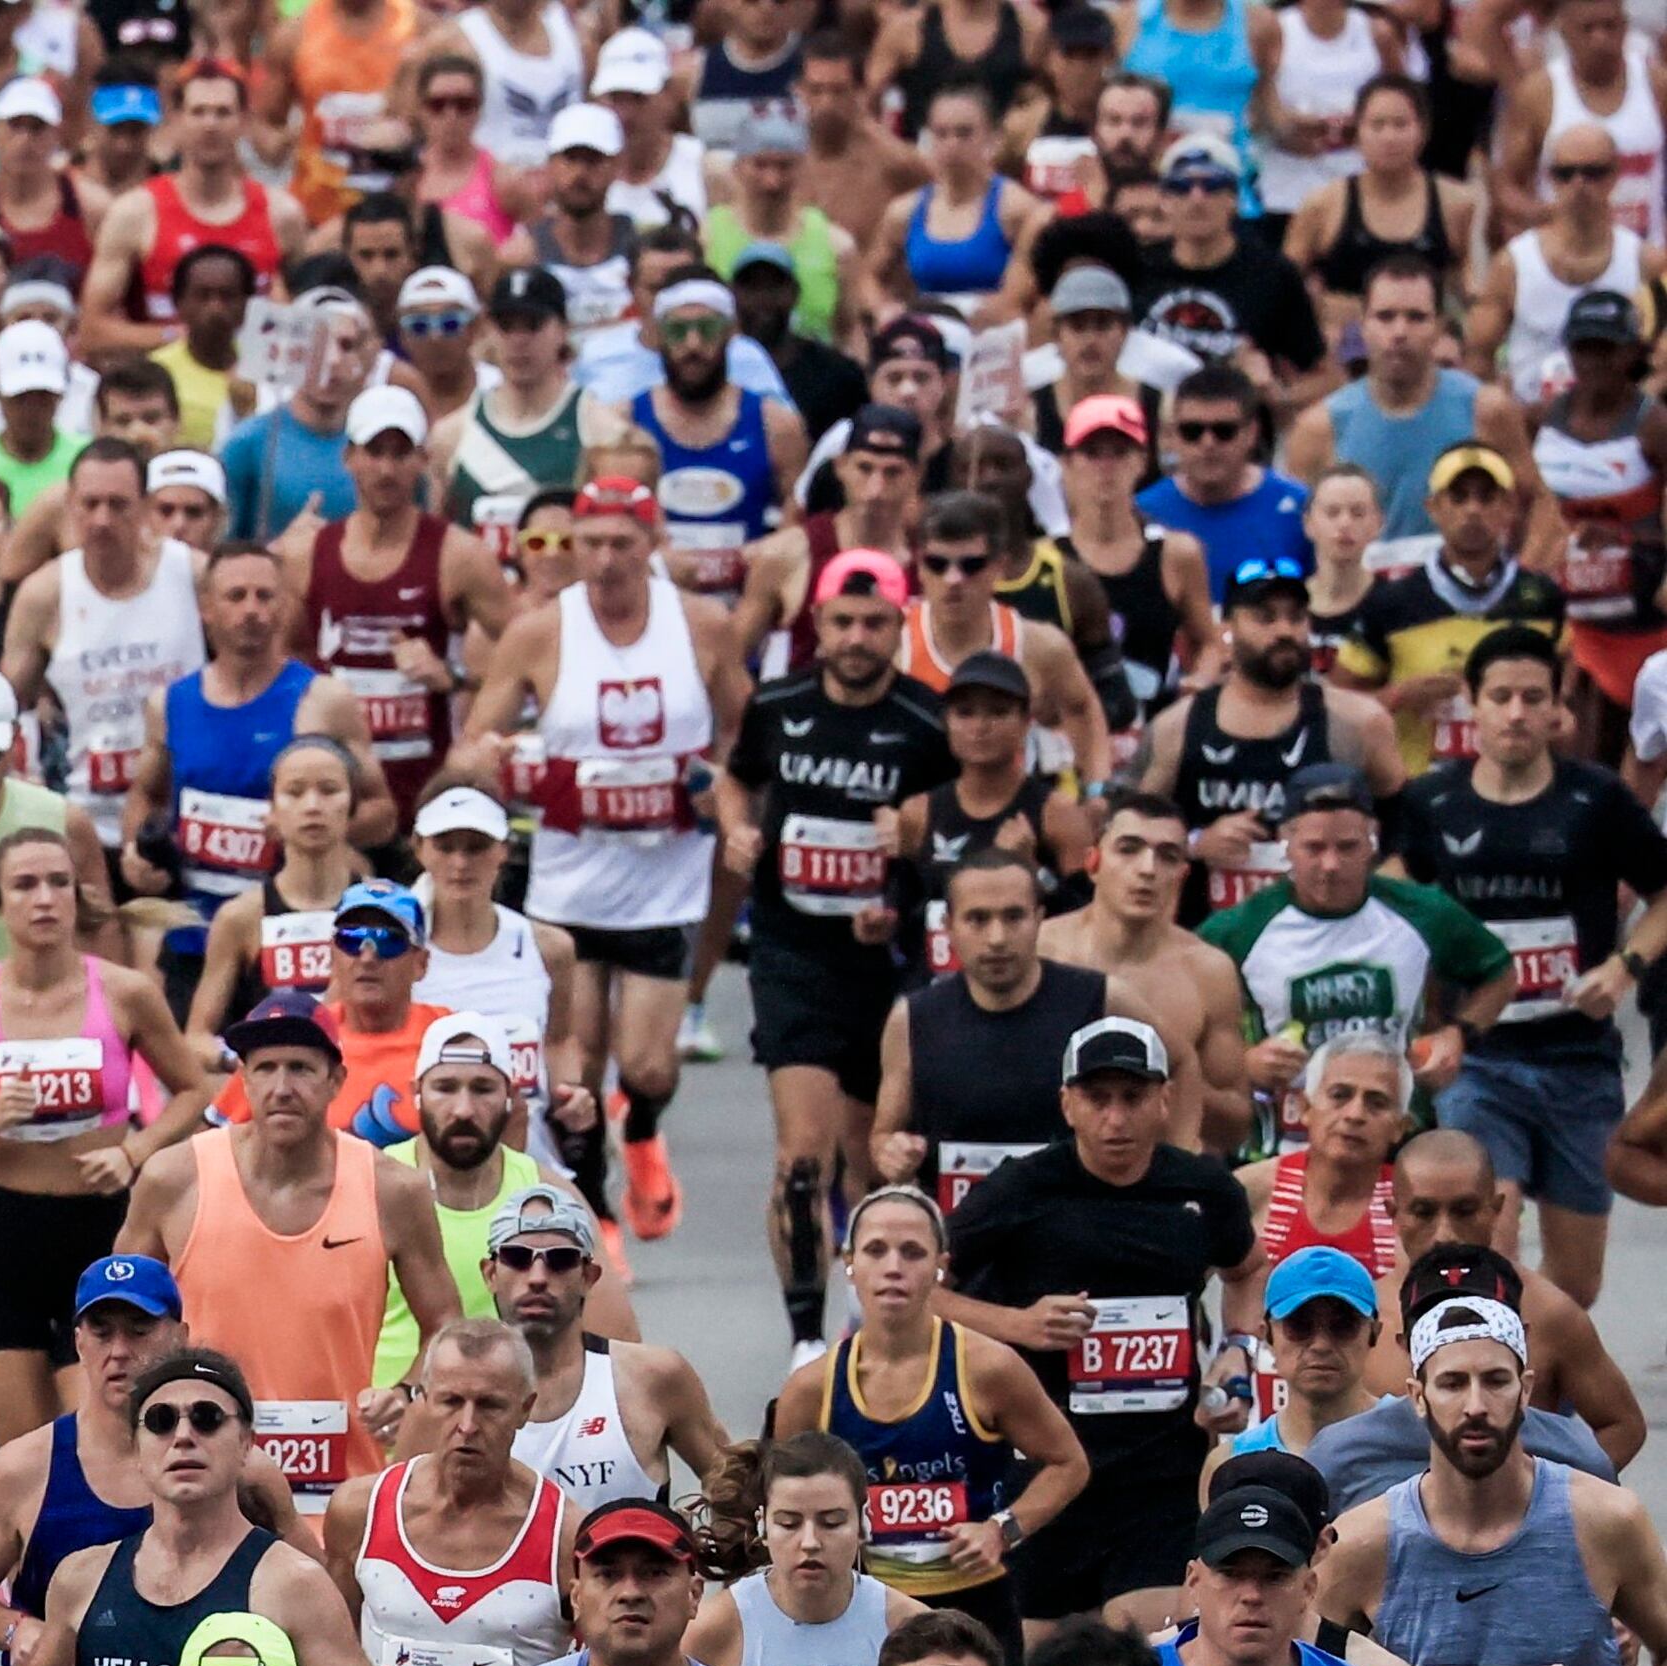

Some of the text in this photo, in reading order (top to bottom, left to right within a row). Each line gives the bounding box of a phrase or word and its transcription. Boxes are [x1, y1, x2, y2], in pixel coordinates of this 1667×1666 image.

[274, 946, 294, 979] B
[1084, 1336, 1178, 1372] B 7237
[266, 1440, 330, 1473] 9231
[881, 1488, 954, 1523] 9236
